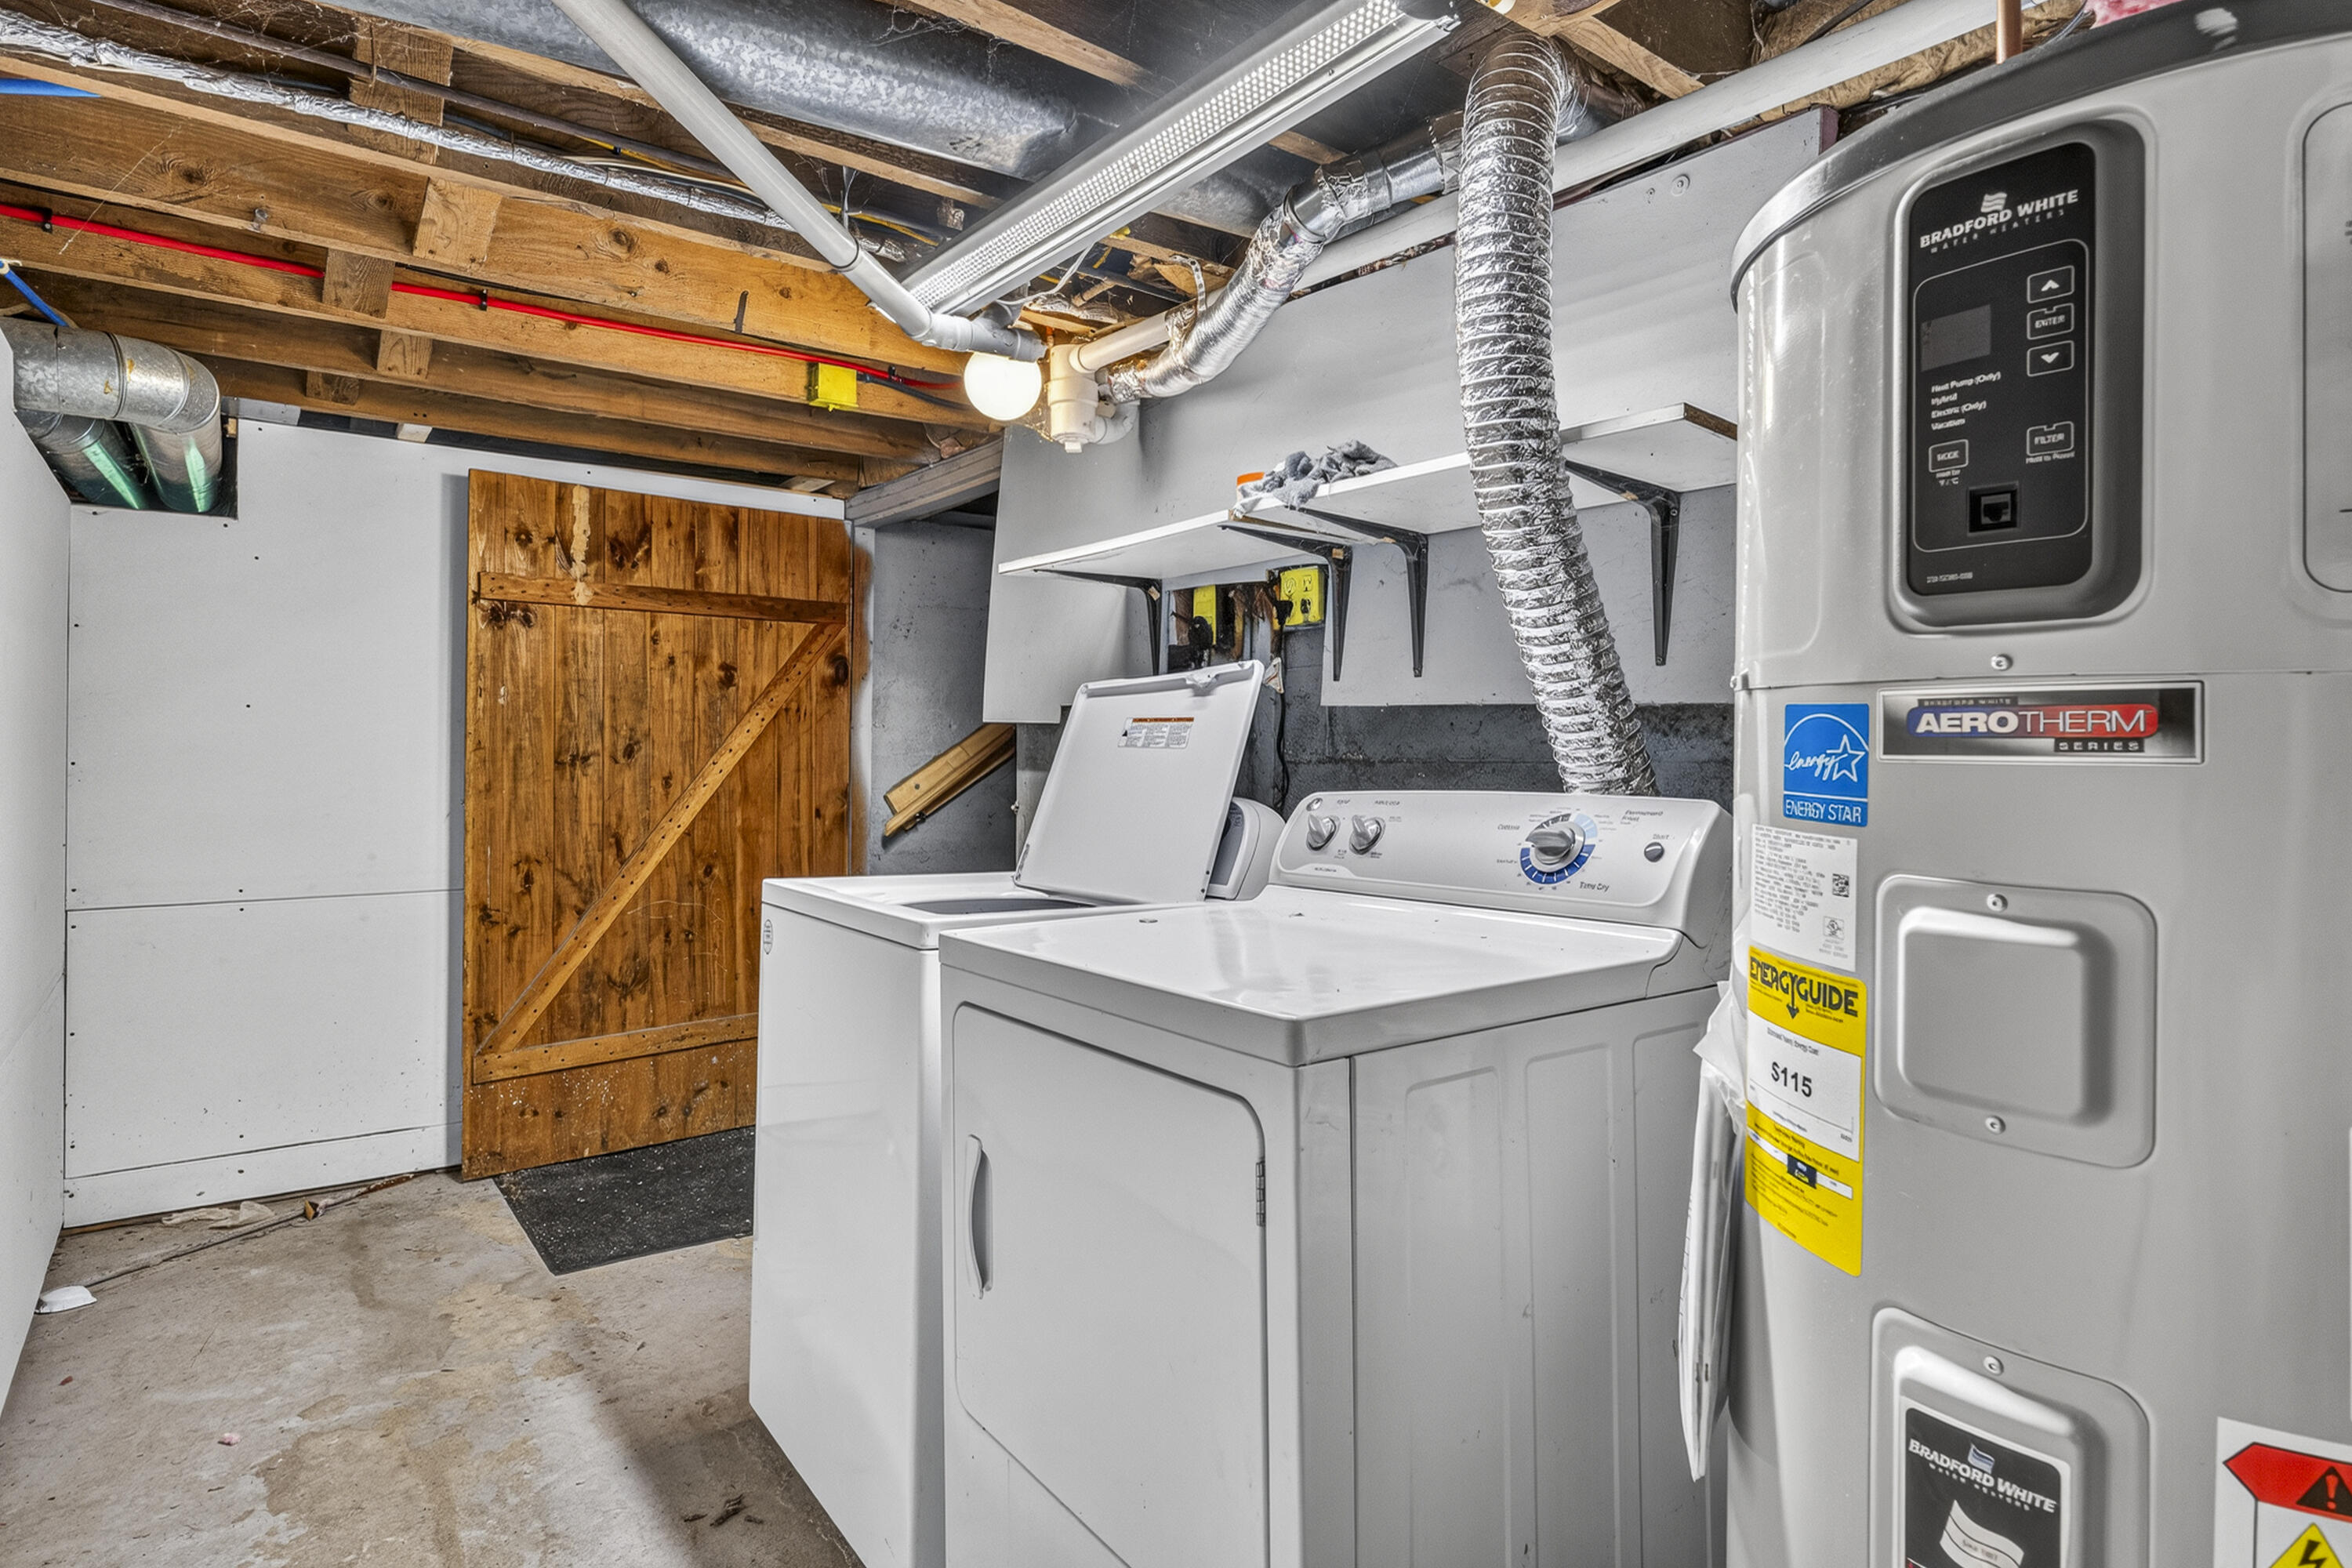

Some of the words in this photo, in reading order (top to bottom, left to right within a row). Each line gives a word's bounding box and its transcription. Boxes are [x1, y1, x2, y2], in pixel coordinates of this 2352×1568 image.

[1920, 209, 2013, 249] BRADFORD
[2017, 190, 2078, 217] WHITE
[1931, 233, 1978, 254] WATER
[1990, 209, 2064, 234] HEATERS
[1916, 709, 2144, 733] AEROTHERM
[2059, 741, 2140, 752] SERIES
[1786, 799, 1826, 819] ENERGY
[1828, 804, 1862, 823] STAR
[1750, 956, 1859, 1019] ENERGYGUIDE
[1770, 1061, 1813, 1098] $115
[1908, 1438, 1994, 1487] BRADFORD
[1997, 1477, 2058, 1513] WHITE
